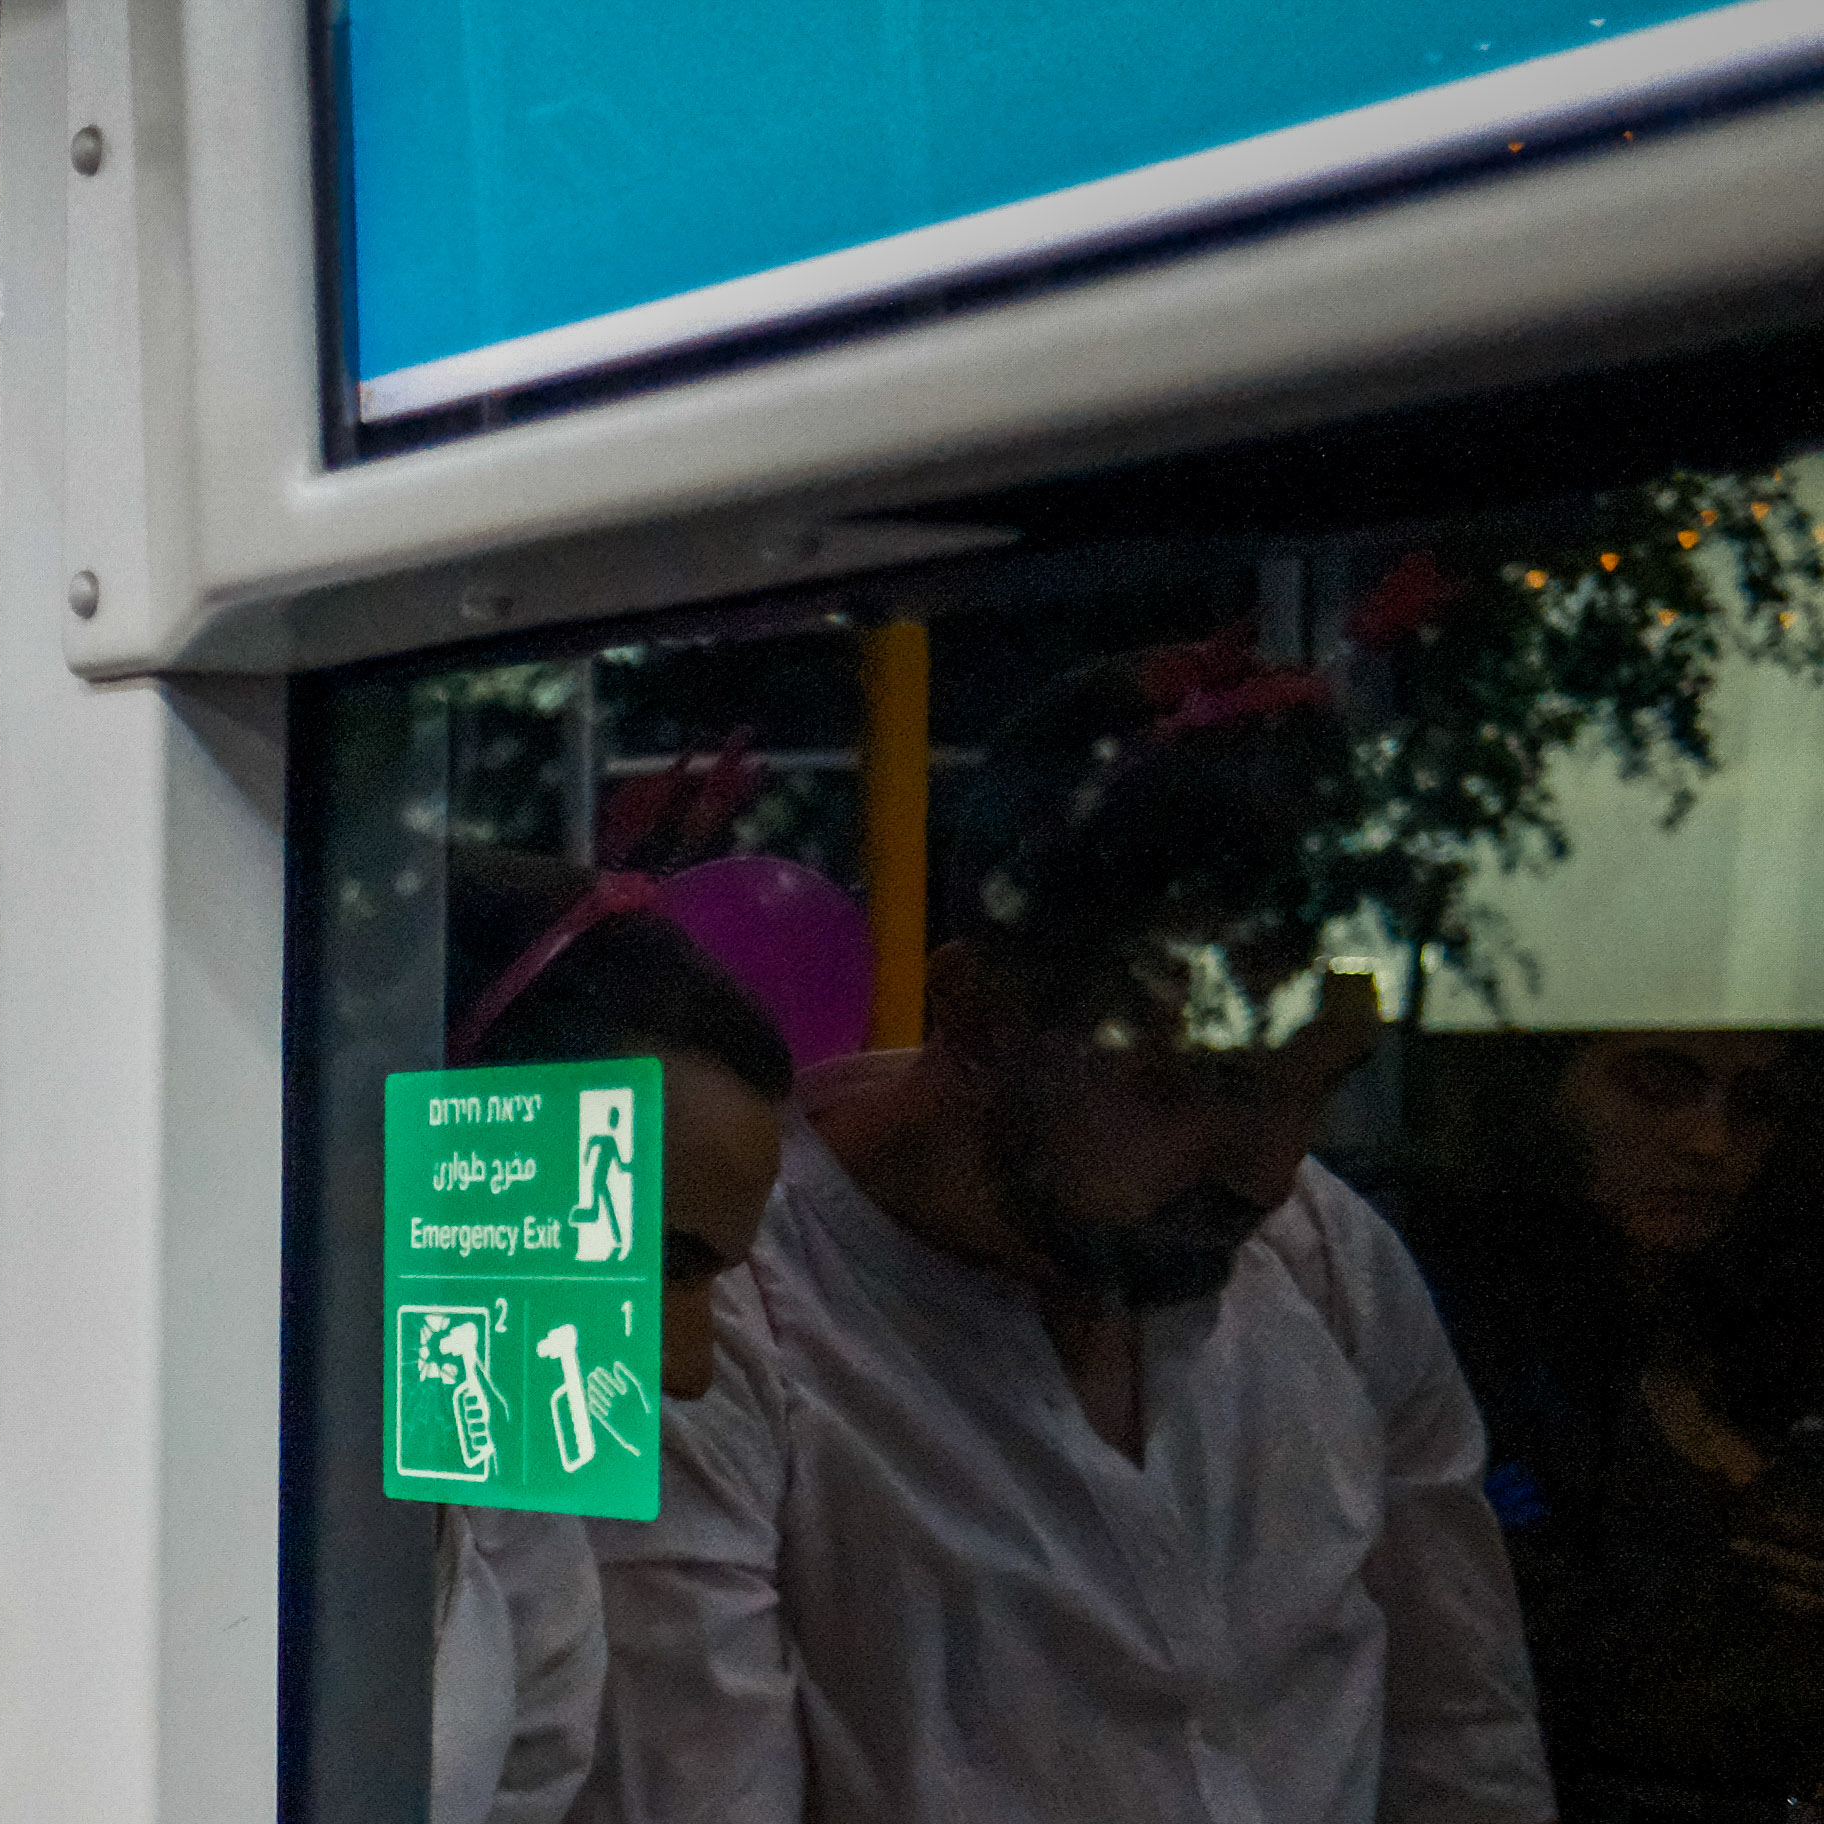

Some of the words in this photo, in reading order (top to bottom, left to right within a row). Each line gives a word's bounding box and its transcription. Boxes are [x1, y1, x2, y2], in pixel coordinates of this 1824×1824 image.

[429, 1097, 481, 1126] חירום
[487, 1094, 542, 1123] יציאת
[490, 1152, 537, 1194] مخرج
[411, 1217, 520, 1257] Emergency
[524, 1215, 562, 1249] Exit
[494, 1297, 508, 1333] 2
[621, 1301, 633, 1337] 1
